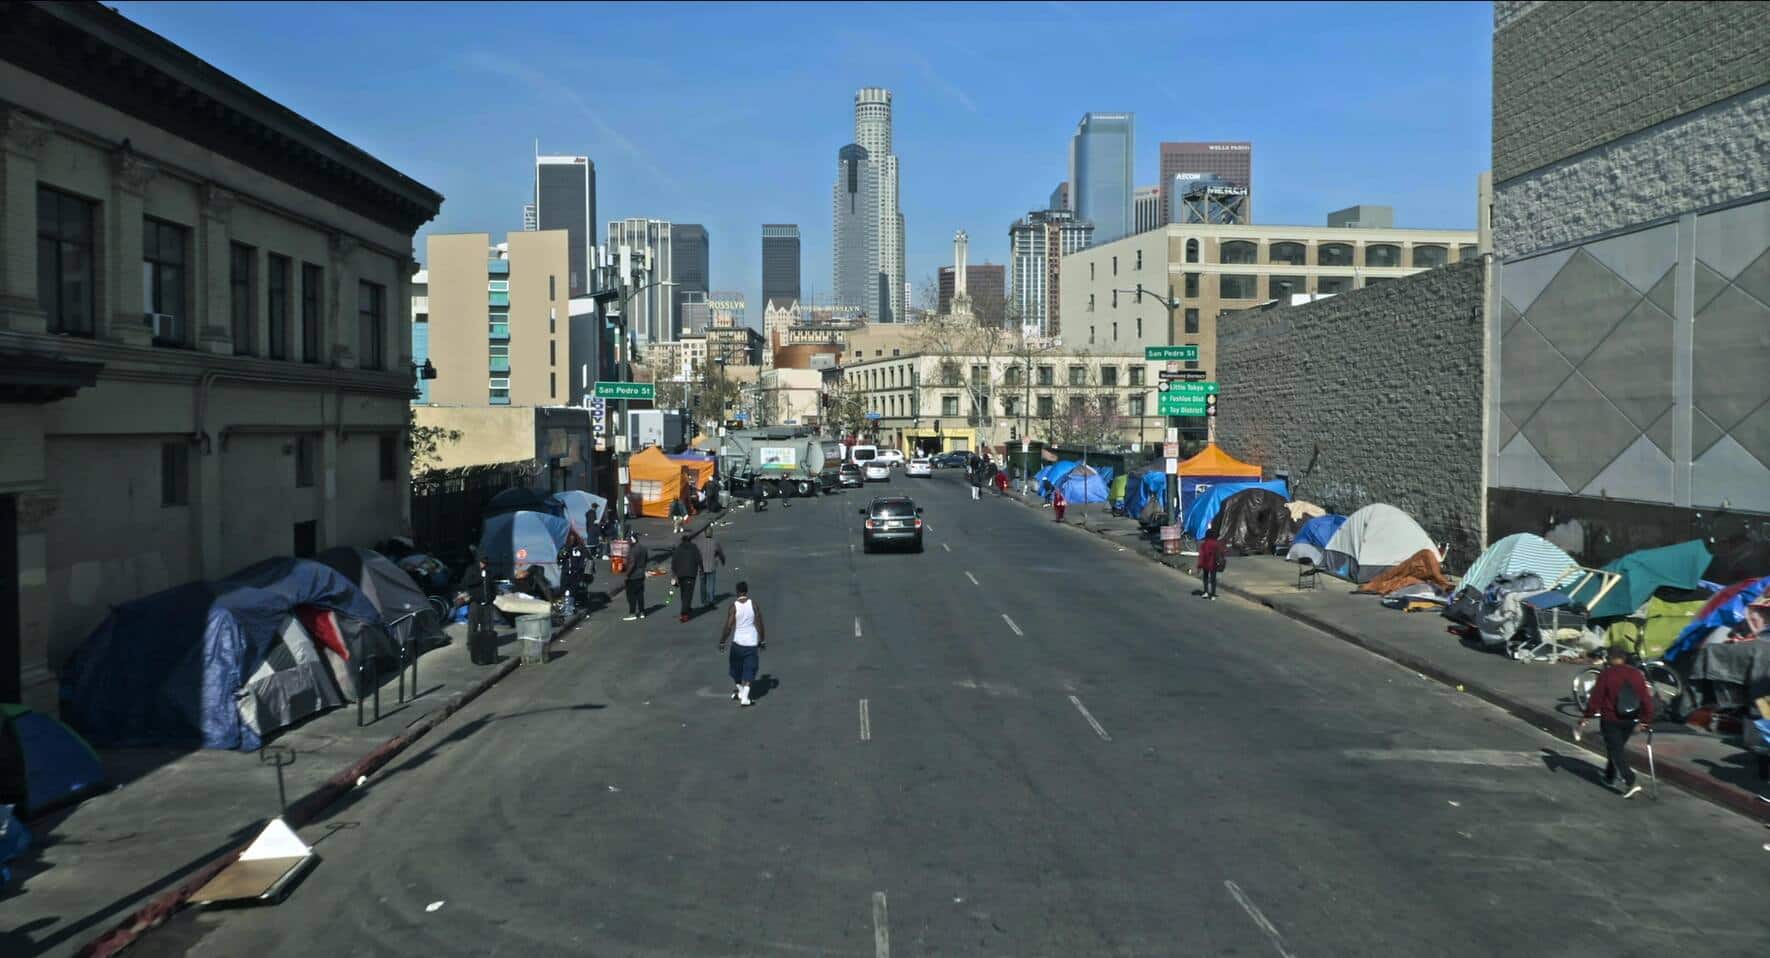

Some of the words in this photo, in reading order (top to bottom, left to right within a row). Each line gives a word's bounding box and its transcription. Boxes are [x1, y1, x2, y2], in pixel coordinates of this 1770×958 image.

[709, 300, 745, 309] ROSSLYN
[598, 386, 613, 394] San
[616, 387, 639, 395] Pedro
[641, 387, 650, 395] St
[1170, 383, 1186, 391] Little
[1187, 383, 1204, 392] Tokyo
[1170, 406, 1180, 414] Toy
